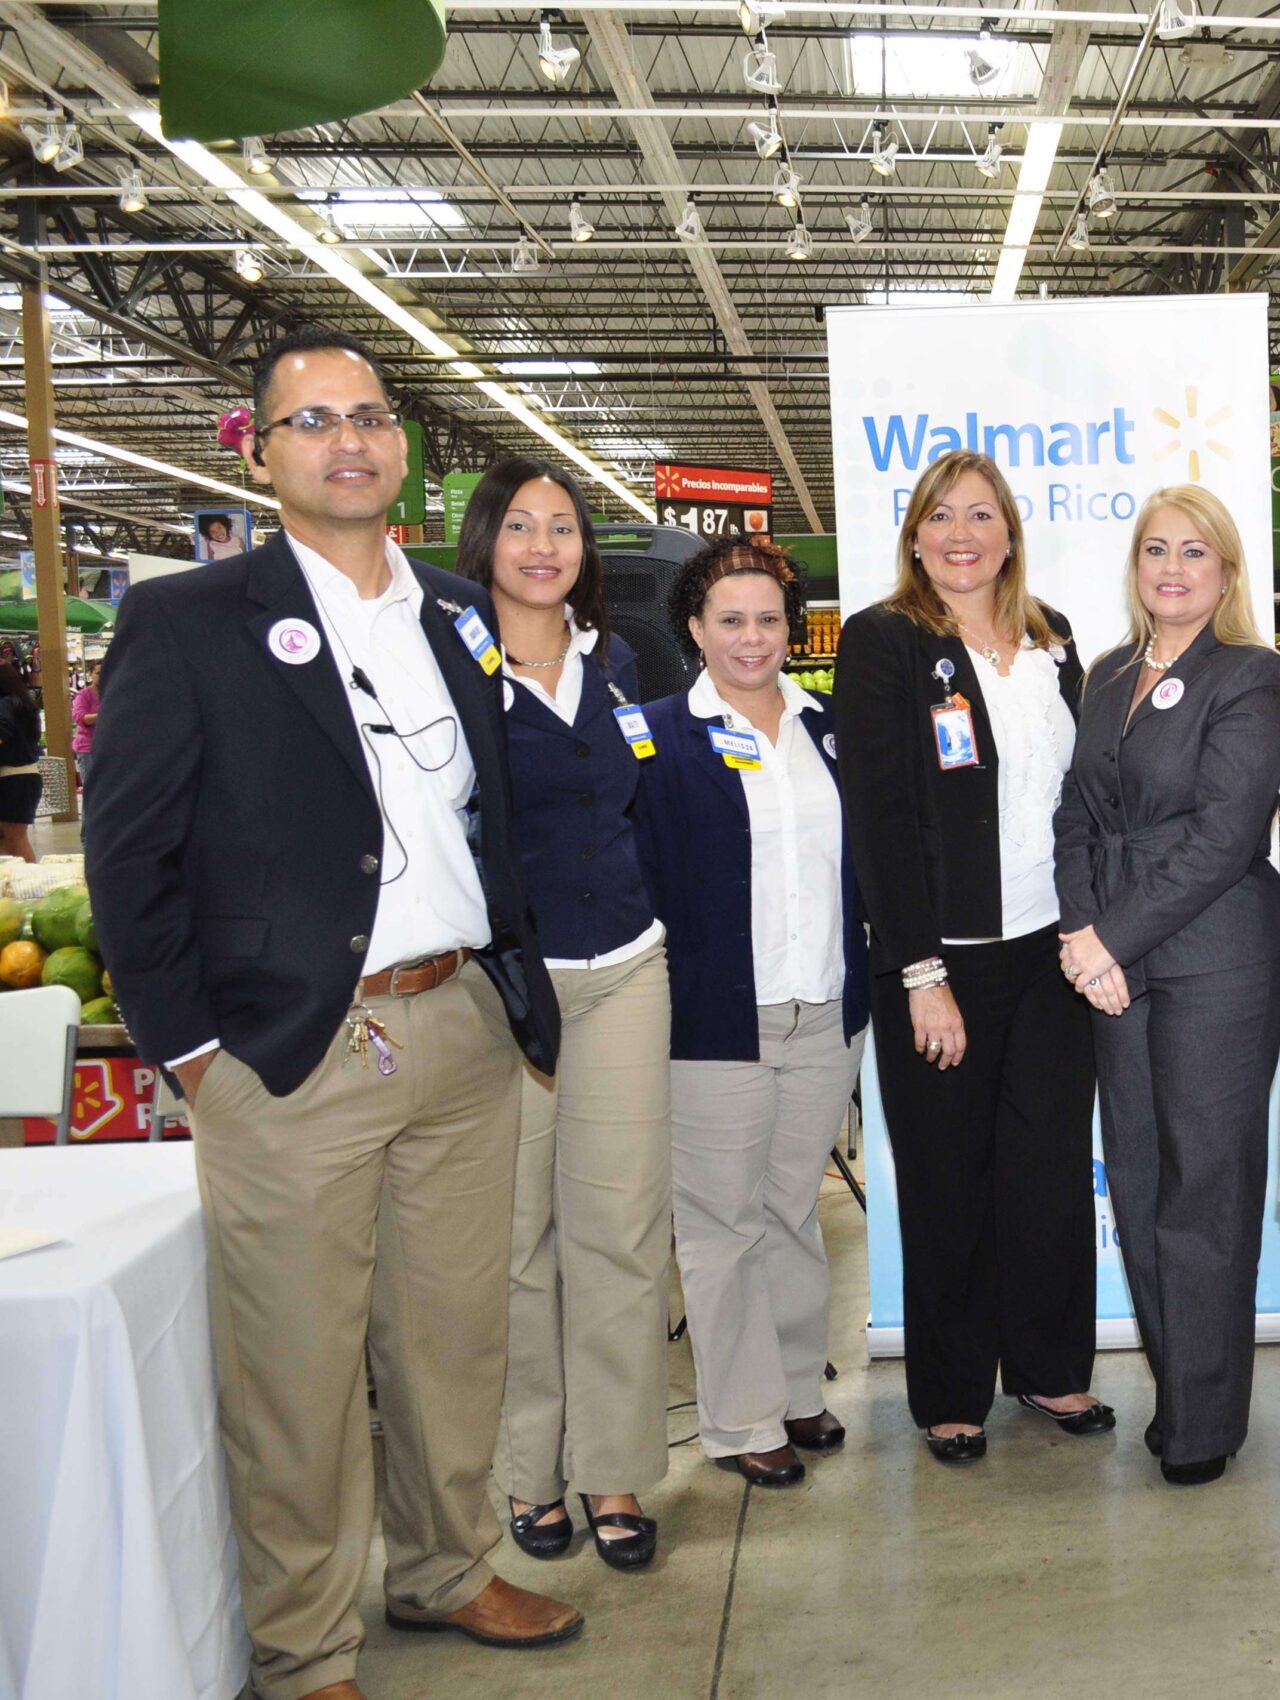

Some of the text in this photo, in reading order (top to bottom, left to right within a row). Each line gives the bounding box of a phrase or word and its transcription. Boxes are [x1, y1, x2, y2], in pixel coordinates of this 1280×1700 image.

[862, 407, 1136, 473] Walmart
[682, 478, 768, 494] Precios Incomparables
[1048, 483, 1136, 522] Rico
